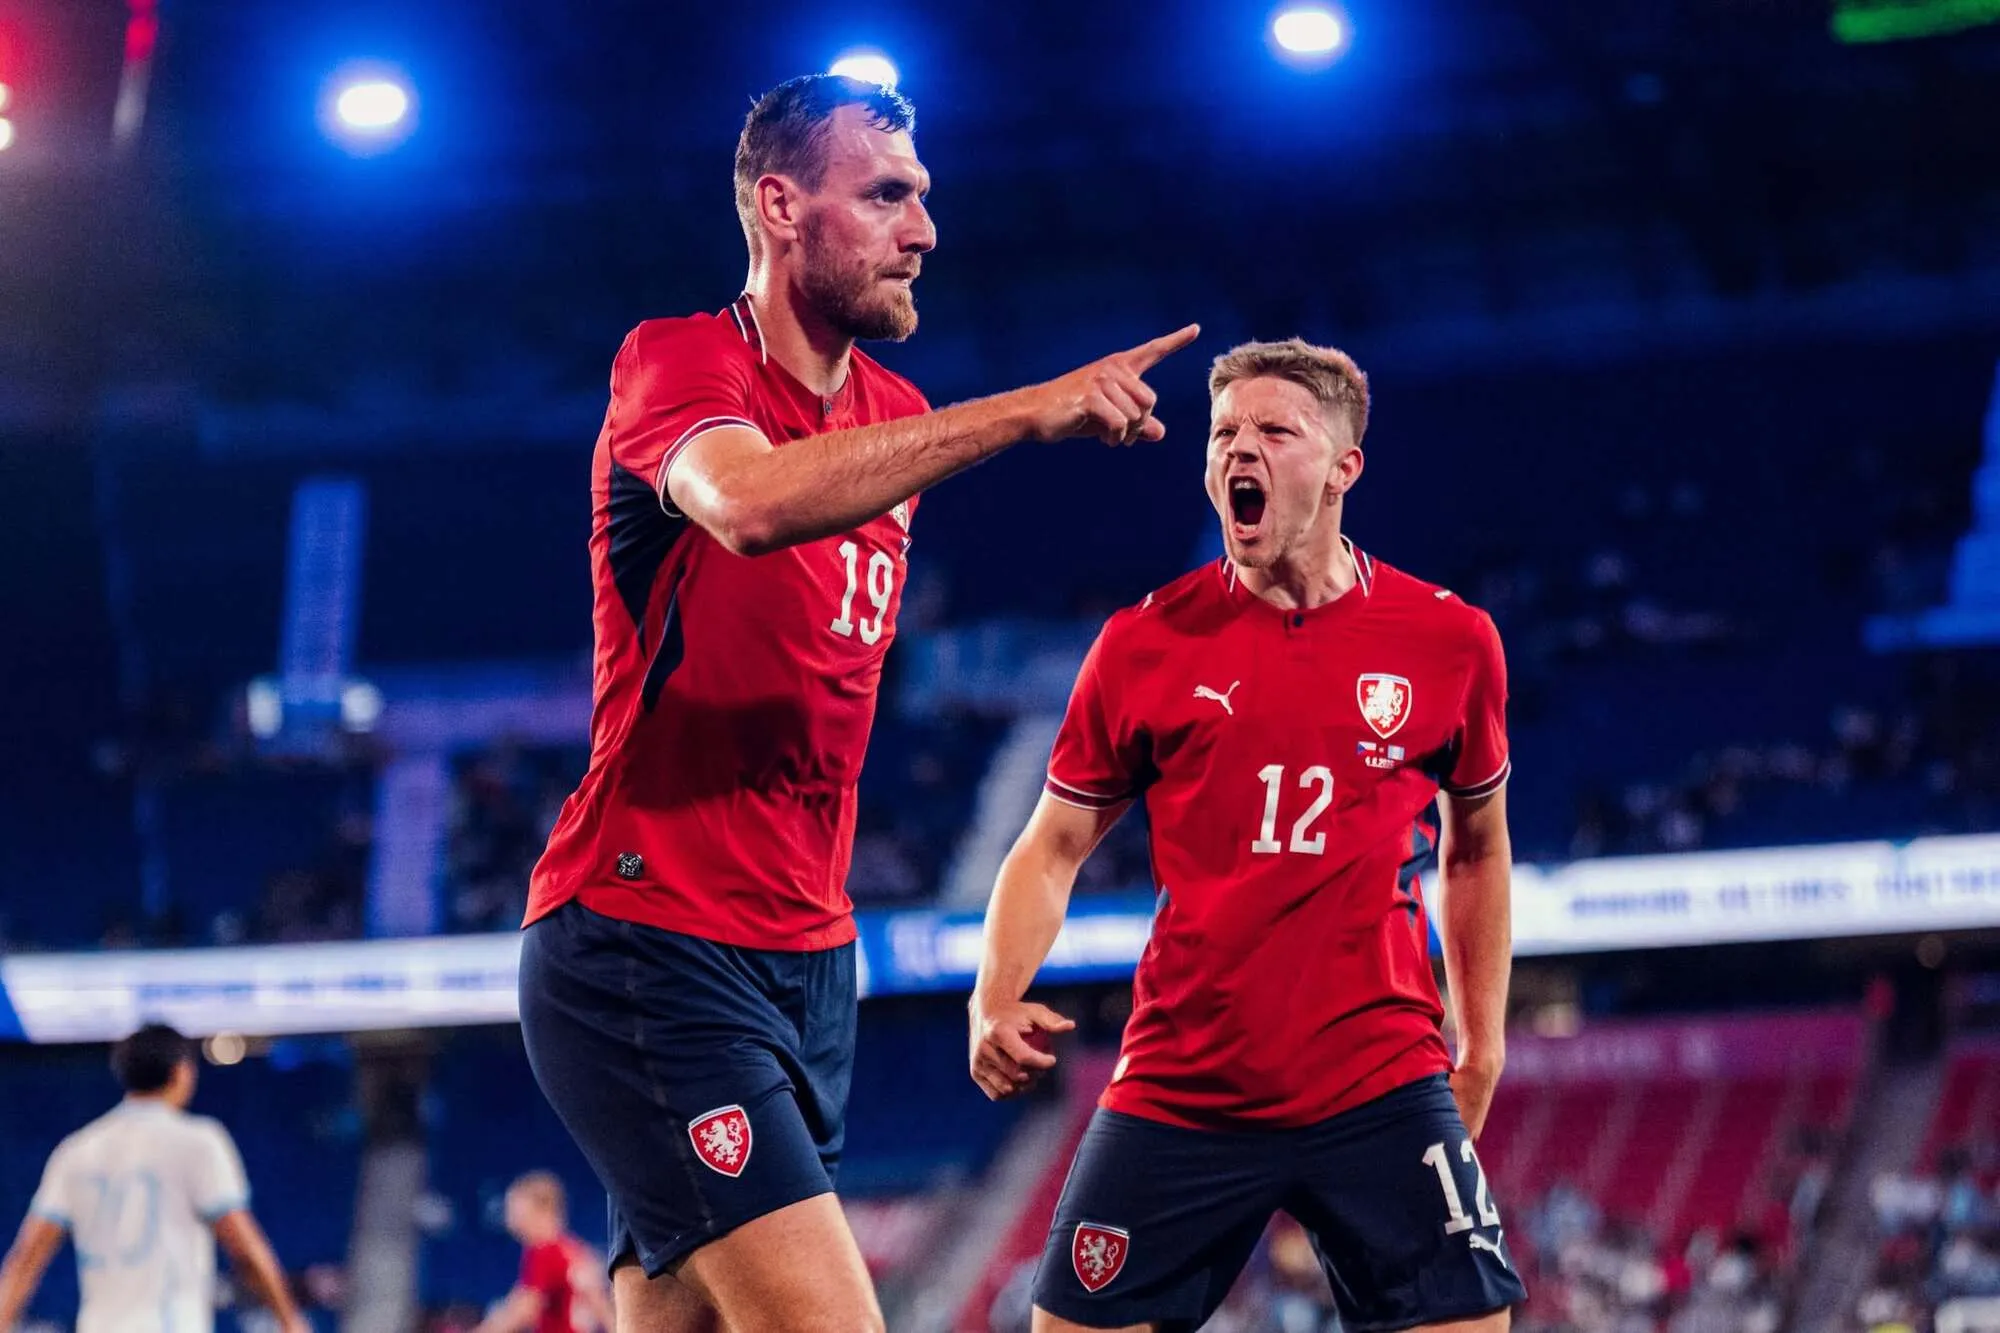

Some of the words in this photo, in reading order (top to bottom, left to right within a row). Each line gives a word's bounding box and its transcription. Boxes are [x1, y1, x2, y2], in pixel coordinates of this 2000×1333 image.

[830, 540, 894, 646] 19
[1251, 764, 1334, 855] 12
[1422, 1140, 1500, 1235] 12
